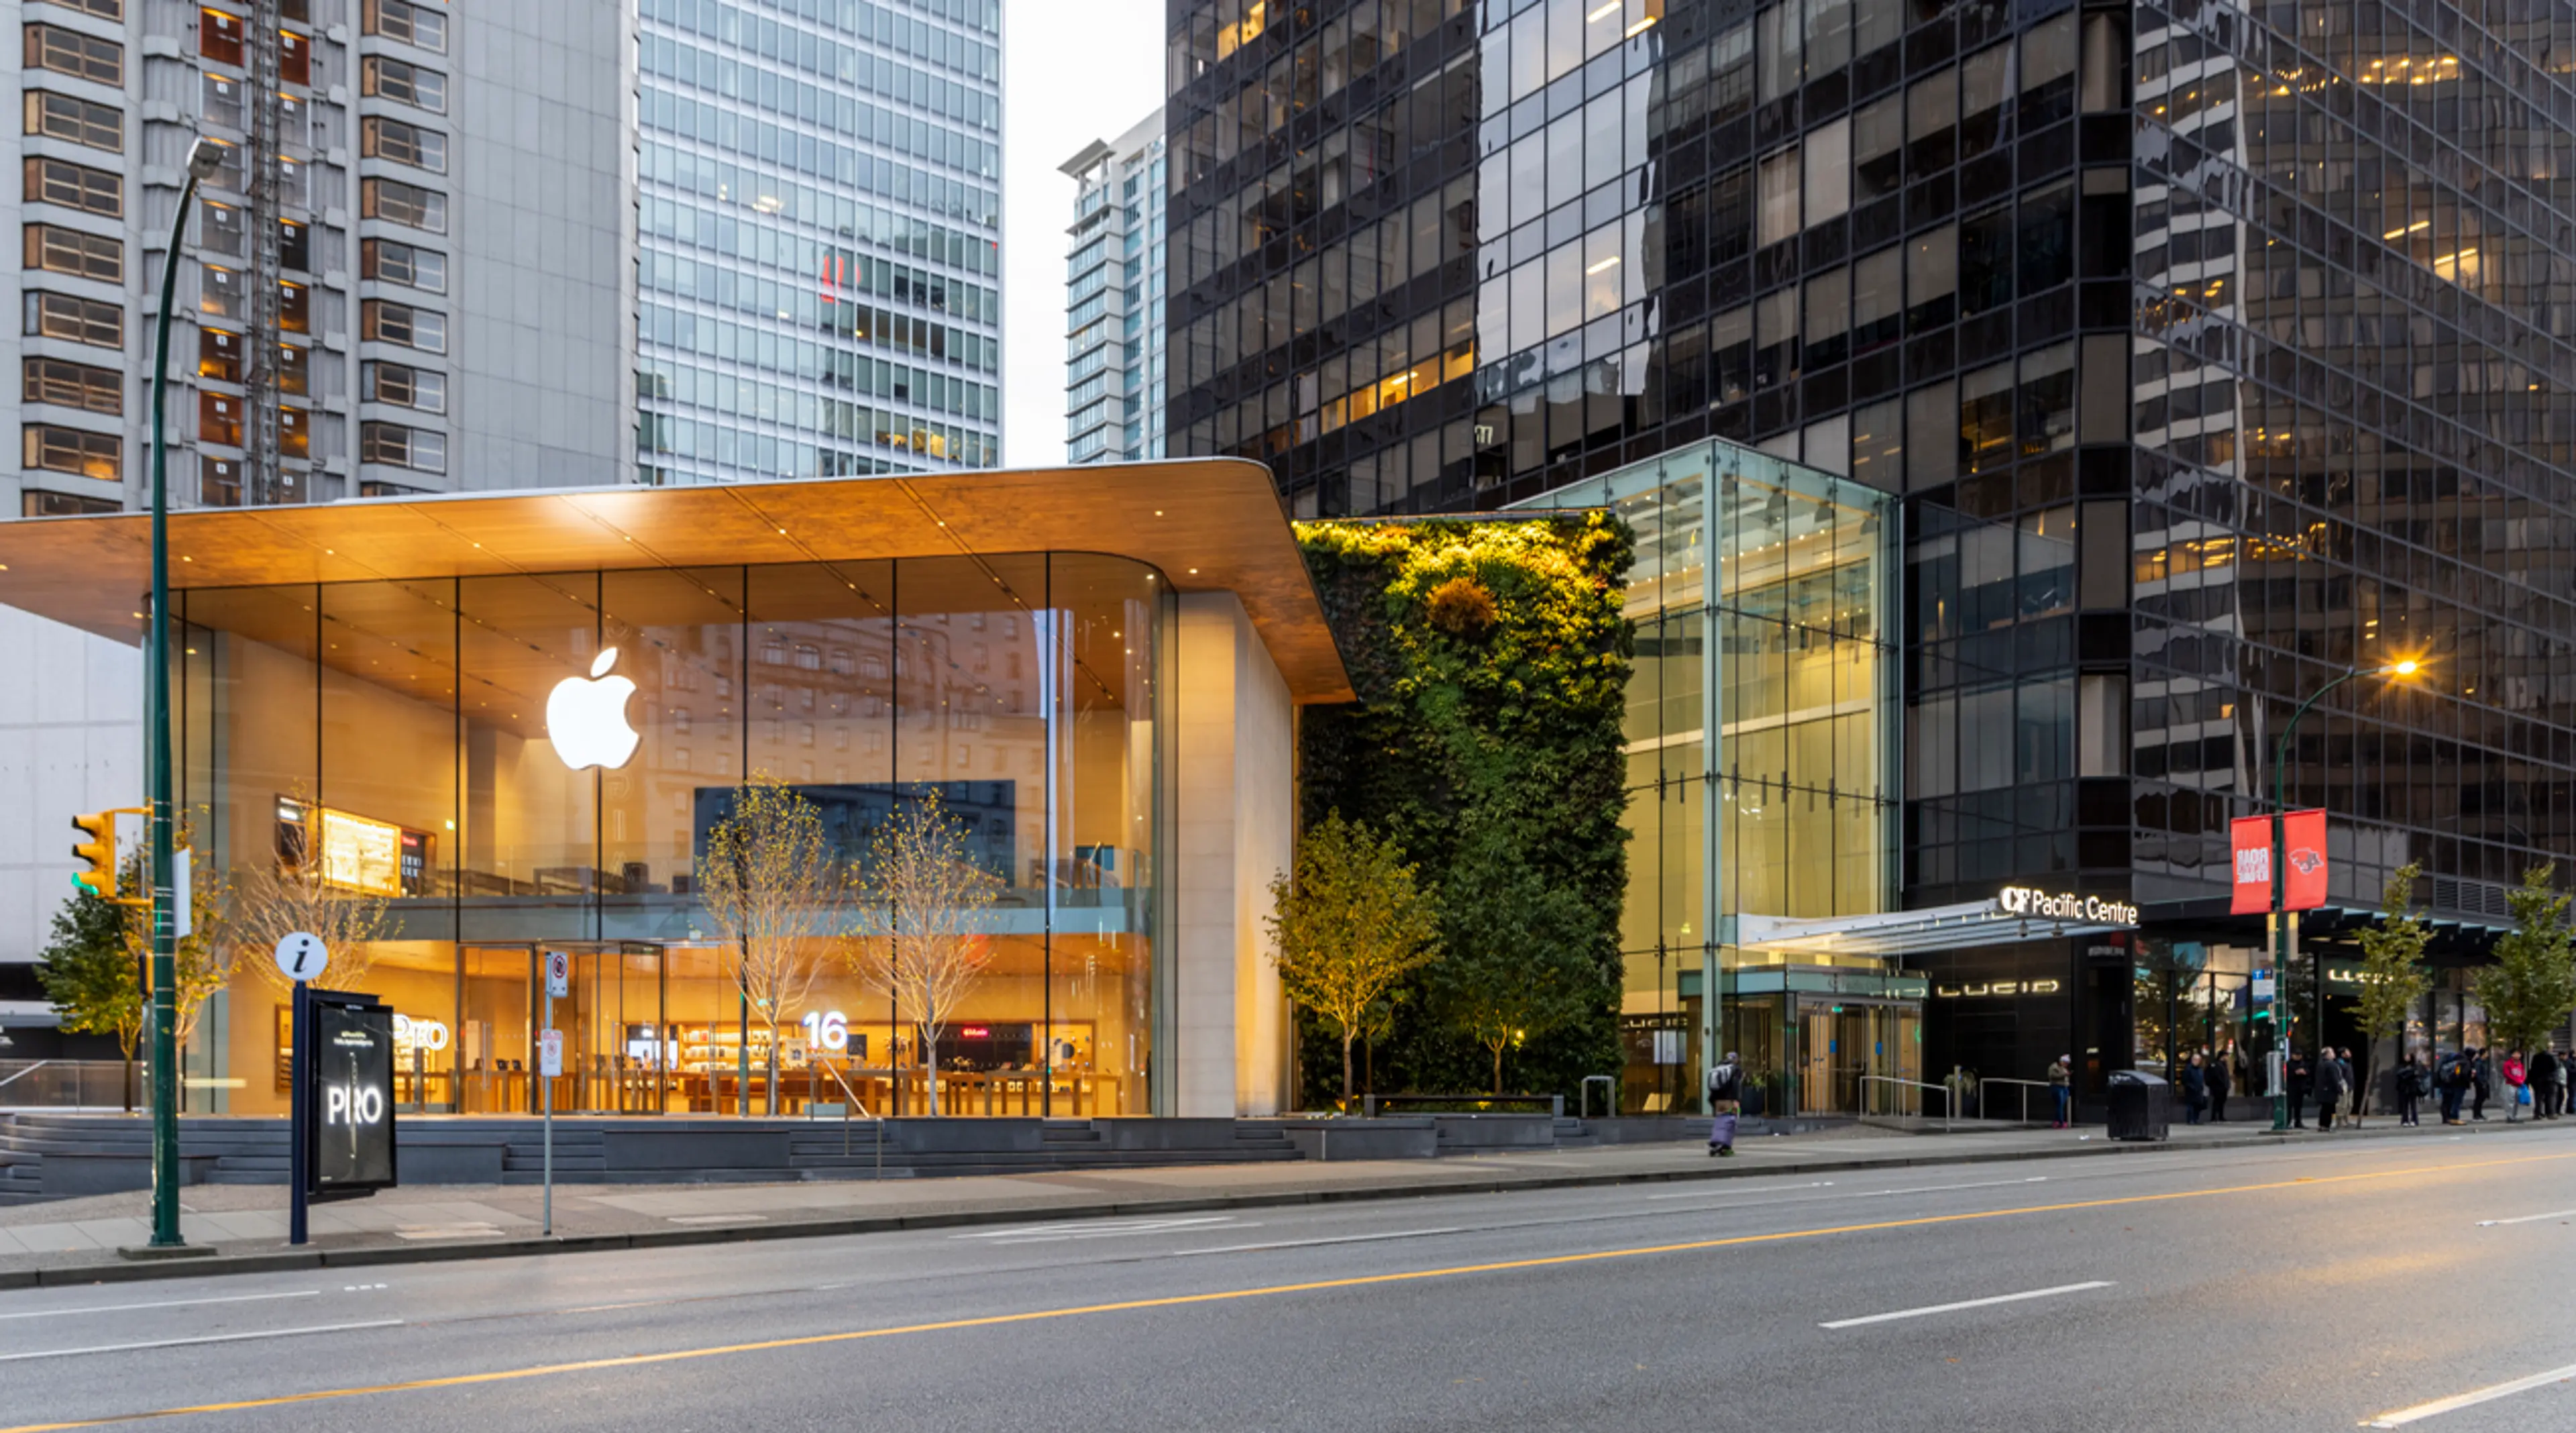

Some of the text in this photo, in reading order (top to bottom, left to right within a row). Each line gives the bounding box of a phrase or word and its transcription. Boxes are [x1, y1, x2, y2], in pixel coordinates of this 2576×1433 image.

[2001, 886, 2138, 925] CF Pacific Centre
[1937, 979, 2060, 998] LUCID
[802, 1010, 848, 1050] 16
[327, 1085, 383, 1125] PRO
